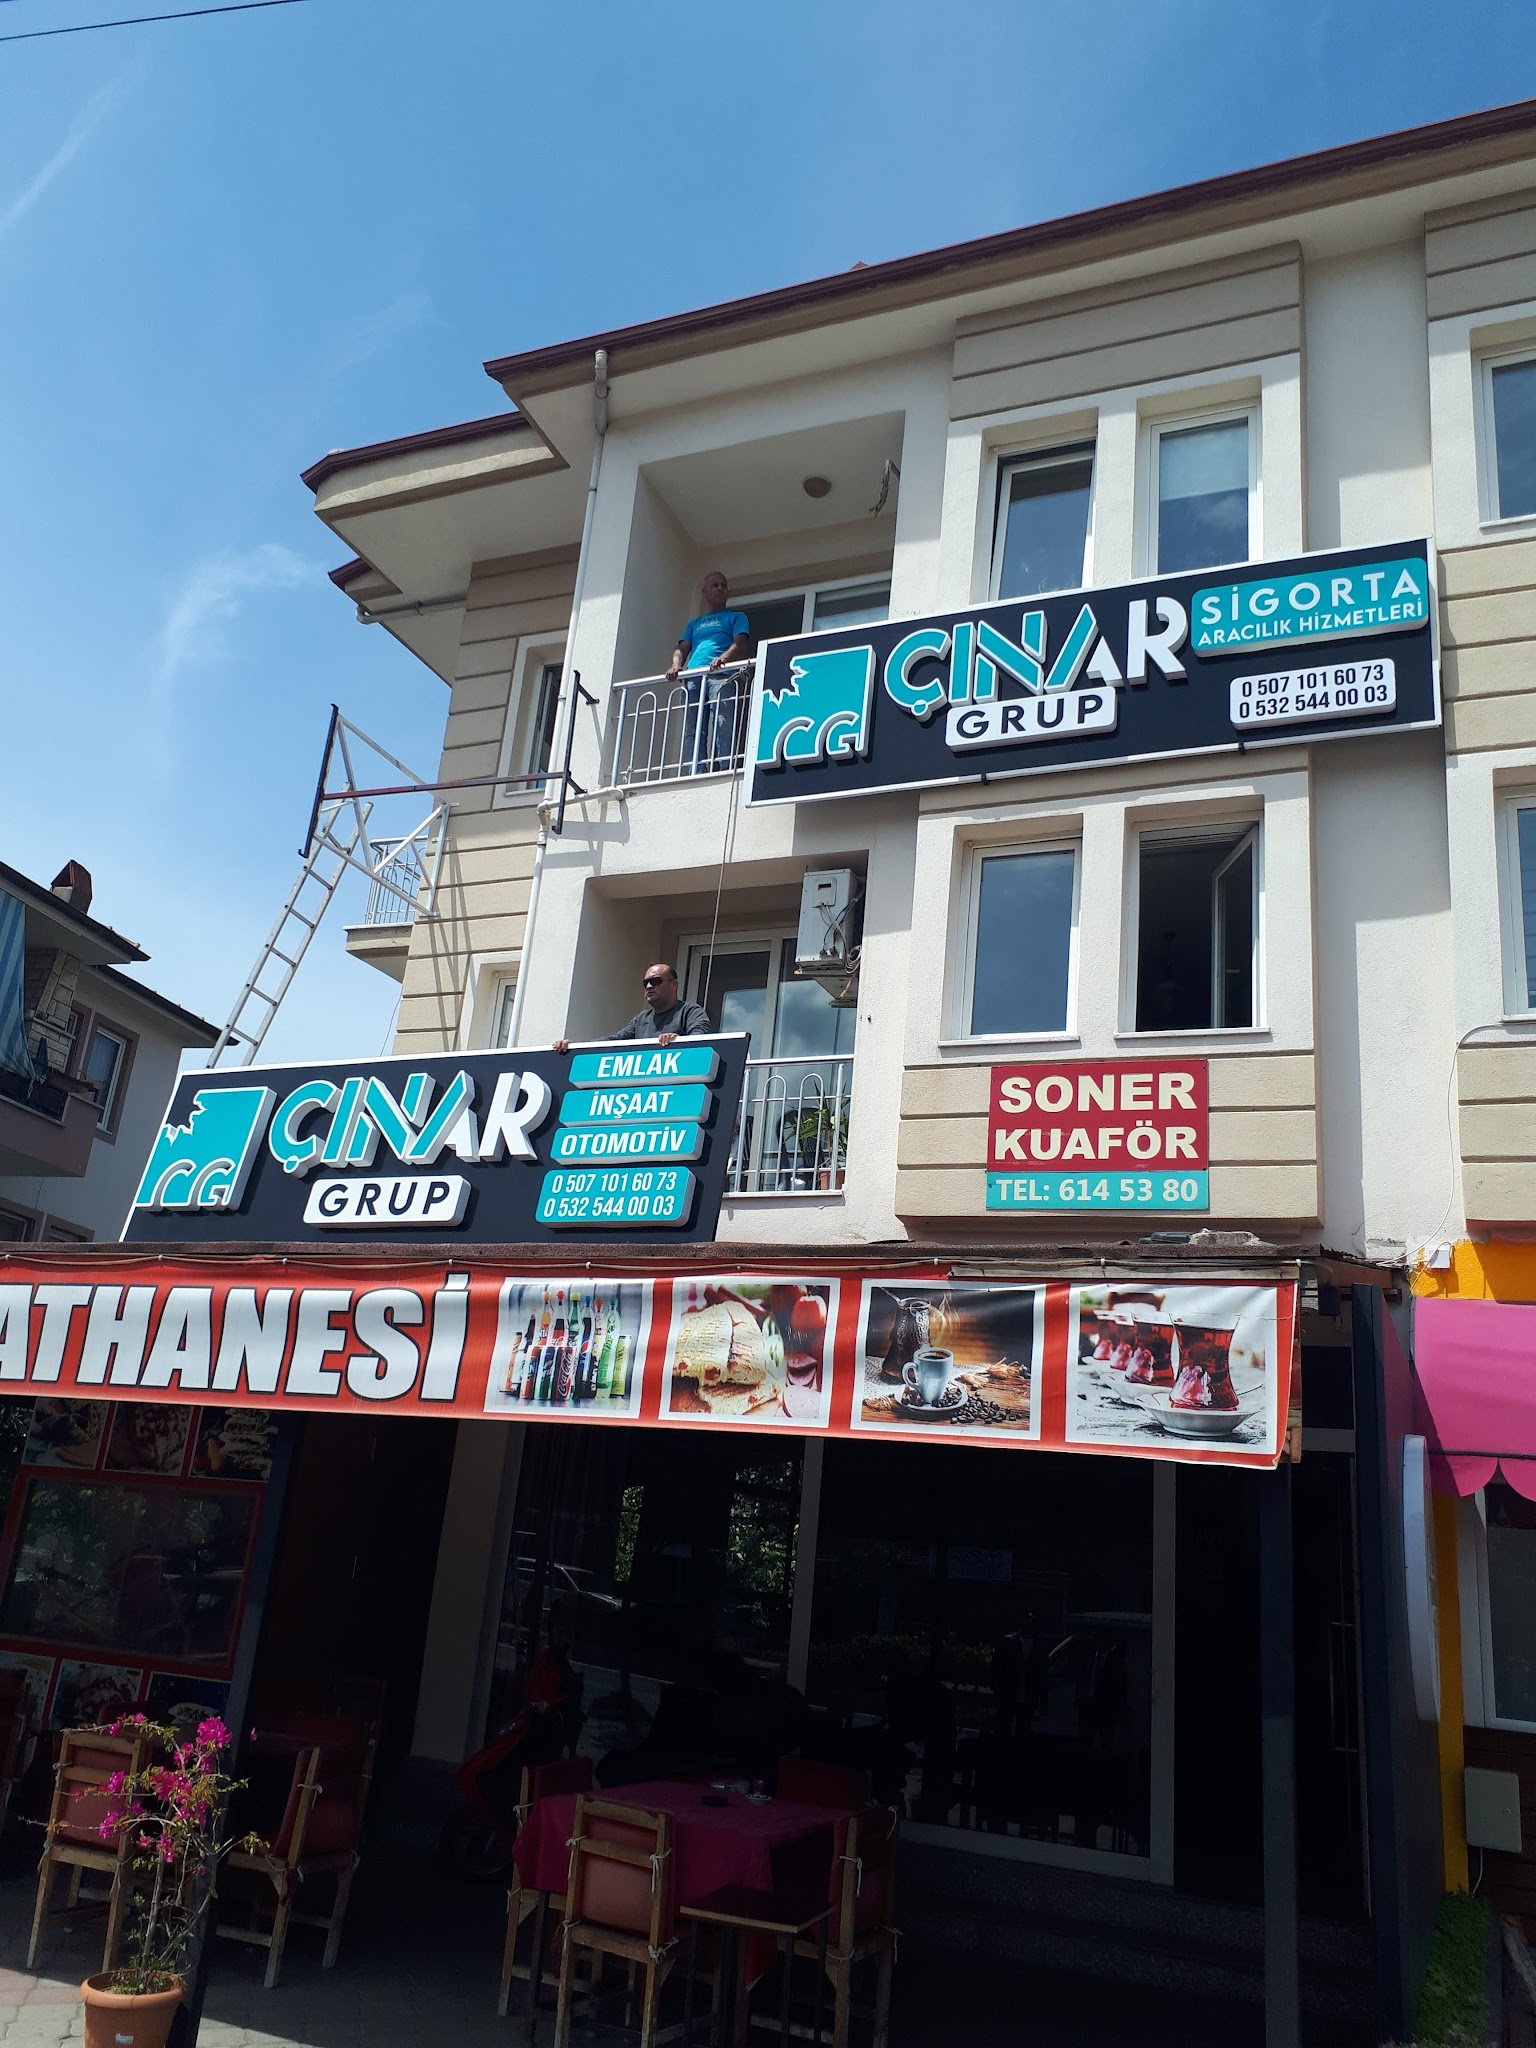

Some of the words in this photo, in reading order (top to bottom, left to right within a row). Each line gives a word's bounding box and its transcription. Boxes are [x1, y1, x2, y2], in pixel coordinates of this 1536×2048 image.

[1200, 568, 1421, 625] SİGORTA
[1198, 618, 1292, 647] ARACILIK
[1299, 597, 1423, 633] HİZMETLERİ
[884, 596, 1188, 720] ÇINAR
[1241, 681, 1252, 698] 0
[1257, 676, 1290, 696] 507
[1297, 671, 1327, 690] 101
[1334, 668, 1356, 686] 60
[1361, 664, 1384, 682] 73
[956, 694, 1104, 739] GRUP
[1239, 702, 1250, 718] 0
[1255, 697, 1290, 716] 532
[1295, 692, 1330, 711] 544
[1335, 688, 1359, 707] 00
[1364, 685, 1388, 703] 03
[597, 1051, 682, 1079] EMLAK
[588, 1090, 674, 1119] İNŞAAT
[998, 1072, 1198, 1114] SONER
[268, 1070, 551, 1176] ÇINAR
[994, 1119, 1199, 1160] KUAFÖR
[560, 1126, 686, 1156] OTOMOTİV
[318, 1181, 450, 1218] GRUP
[551, 1174, 563, 1194] 0
[565, 1173, 597, 1193] 507
[601, 1173, 629, 1192] 101
[631, 1172, 653, 1191] 60
[656, 1171, 677, 1191] 73
[995, 1179, 1050, 1202] TEL:
[1058, 1178, 1110, 1202] 614
[1119, 1178, 1153, 1202] 53
[1161, 1178, 1199, 1202] 80
[543, 1197, 556, 1218] 0
[557, 1196, 590, 1217] 532
[591, 1196, 625, 1217] 544
[627, 1195, 651, 1216] 00
[652, 1194, 676, 1216] 03
